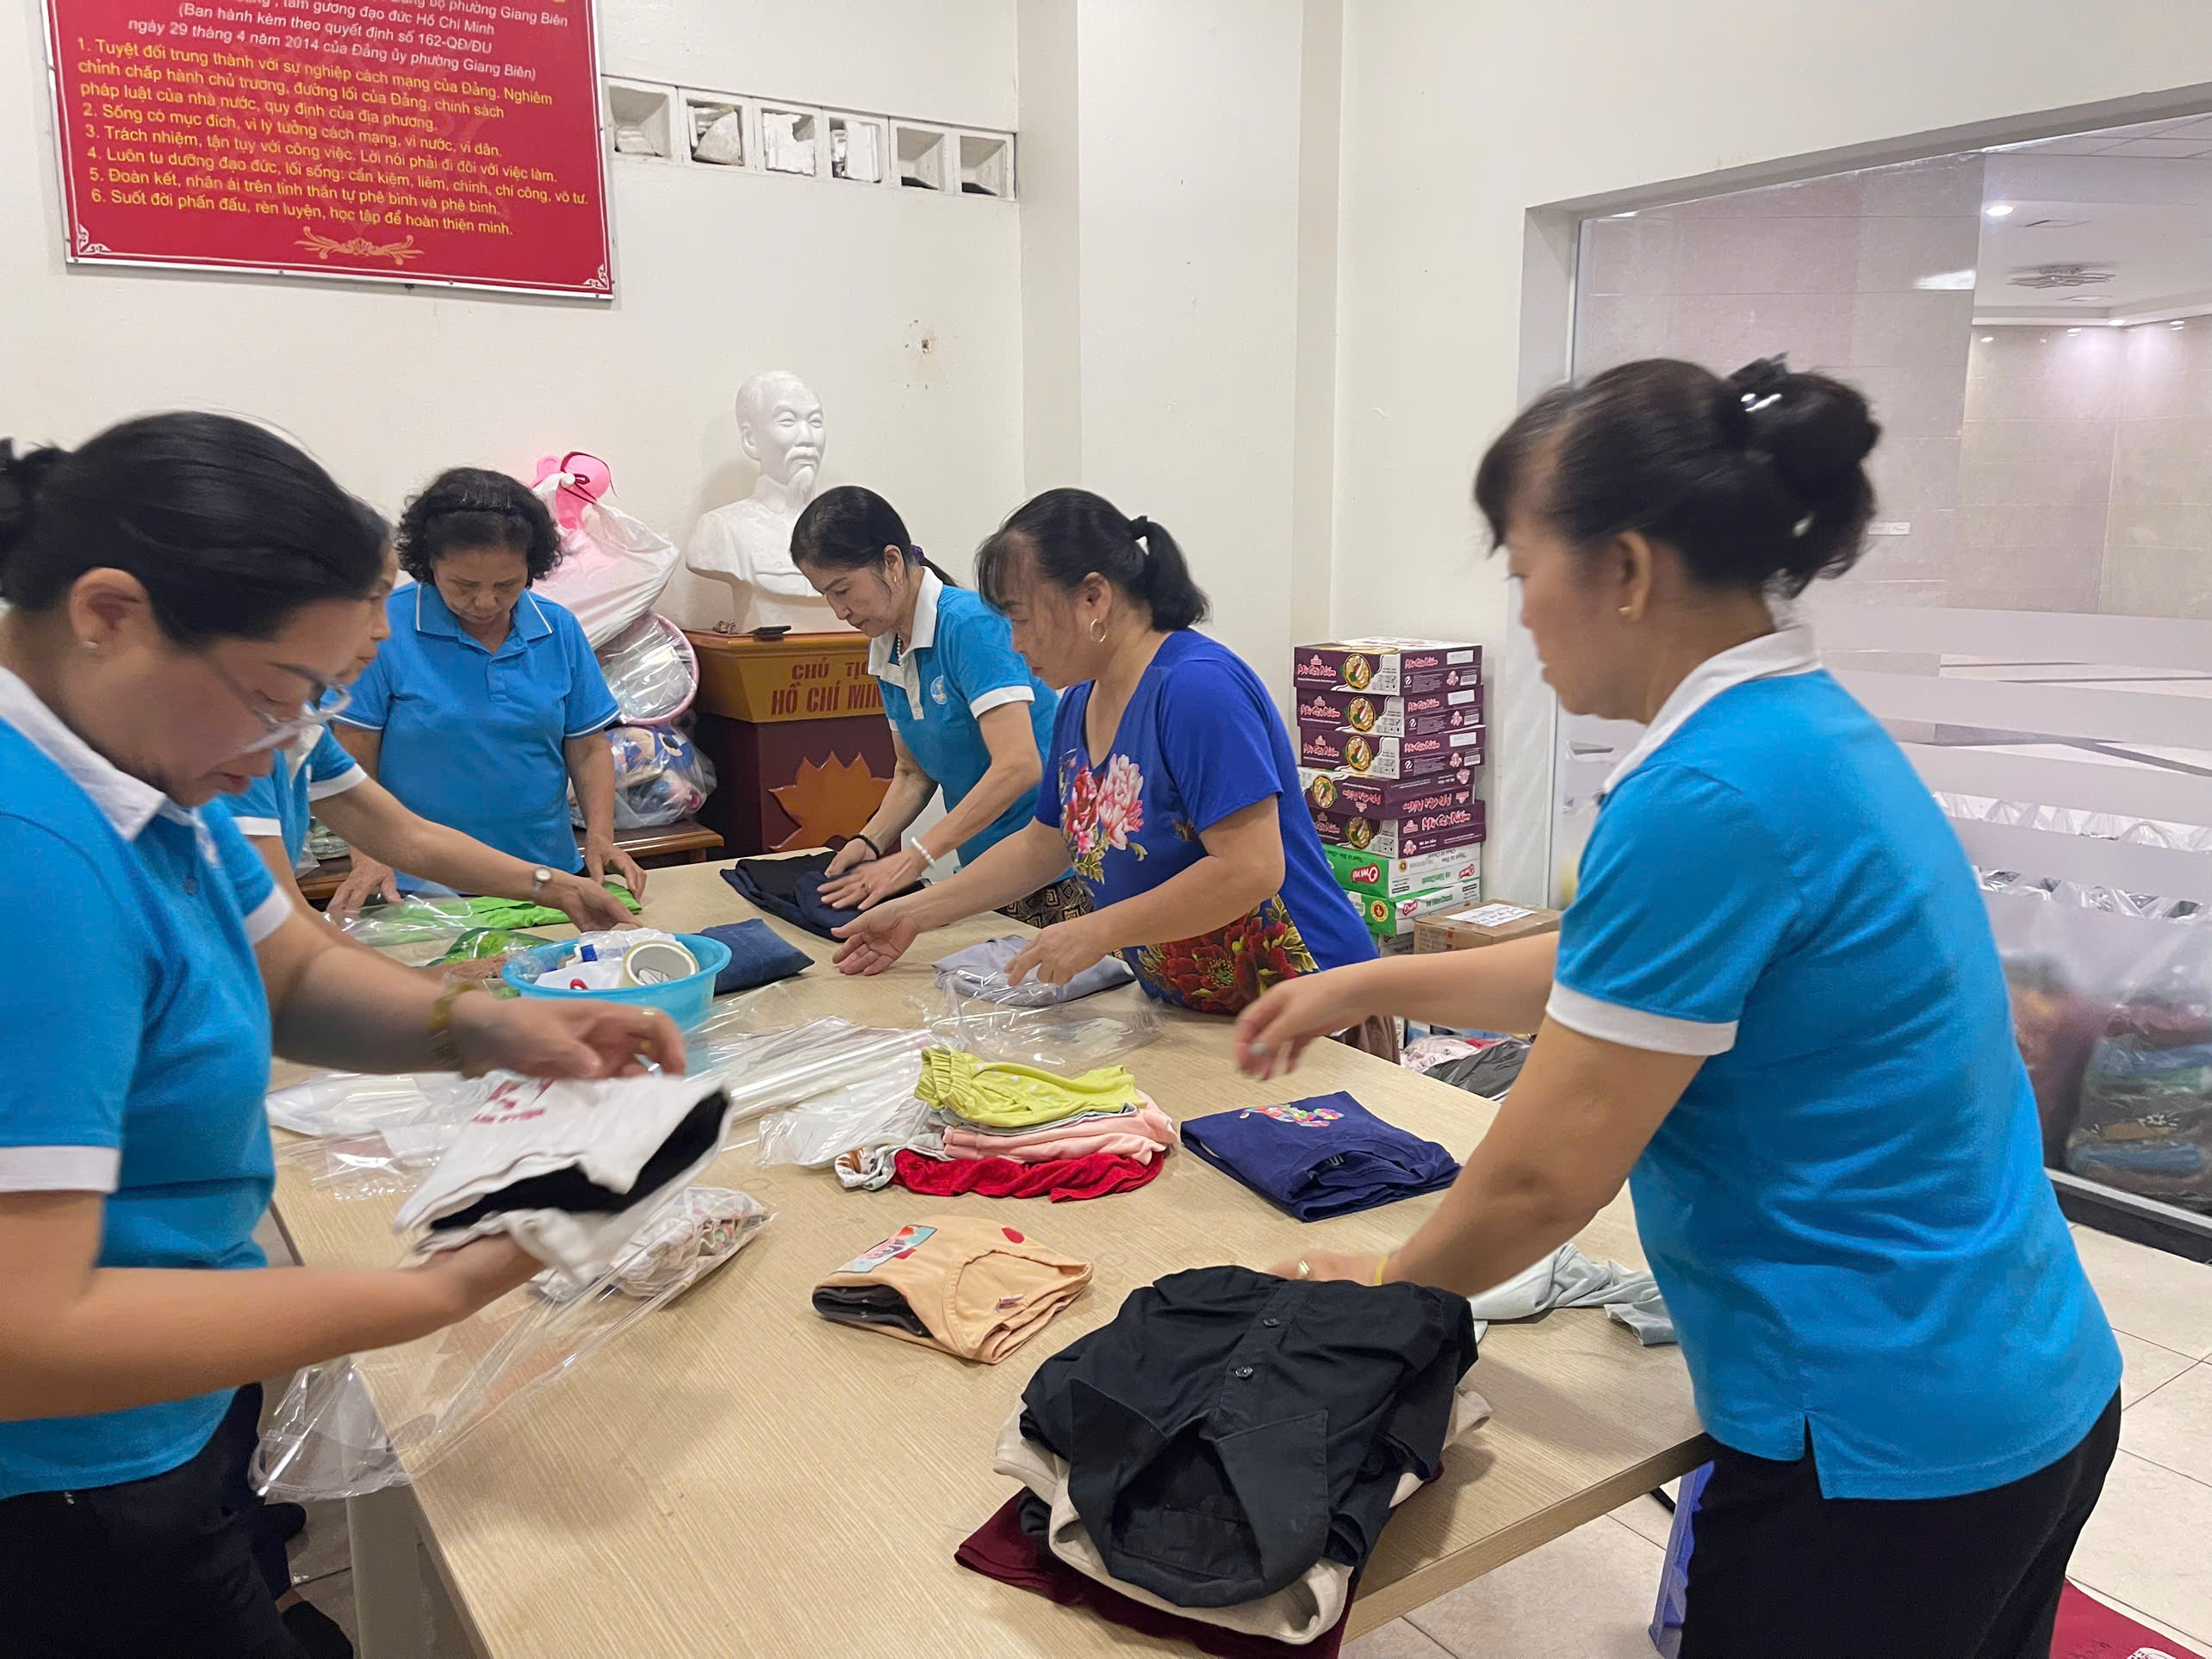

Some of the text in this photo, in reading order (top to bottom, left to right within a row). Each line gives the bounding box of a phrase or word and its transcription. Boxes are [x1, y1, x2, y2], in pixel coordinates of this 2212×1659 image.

[179, 3, 213, 18] (Ban
[217, 7, 252, 23] hành
[257, 12, 287, 27] kèm
[290, 16, 320, 31] theo
[325, 22, 362, 37] quyết
[366, 27, 394, 41] định
[398, 30, 414, 43] số
[313, 2, 356, 19] gương
[359, 6, 385, 21] đạo
[388, 9, 413, 23] đức
[439, 16, 460, 30] Chí
[464, 20, 494, 34] Minh
[449, 0, 496, 19] phường
[500, 6, 537, 25] Giang
[541, 12, 568, 27] Biên
[95, 39, 140, 59] Tuyệt
[143, 41, 165, 58] đối
[171, 48, 208, 67] trung
[213, 53, 254, 68] thành
[258, 58, 278, 71] với
[283, 62, 301, 76] sự
[304, 64, 351, 82] nghiệp
[356, 69, 388, 84] cách
[392, 76, 430, 92] mạng
[434, 78, 457, 93] của
[504, 87, 552, 105] Nghiêm
[128, 19, 536, 82] ngày 29 tháng 4 năm 2014 của Đảng ủy phường Giang Biên)
[78, 59, 121, 76] chỉnh
[125, 65, 162, 83] chấp
[166, 68, 204, 84] hành
[208, 73, 234, 87] chủ
[294, 82, 338, 101] đường
[342, 86, 357, 100] lối
[362, 89, 387, 103] của
[435, 99, 469, 114] chính
[474, 104, 504, 118] sách
[80, 82, 120, 100] pháp
[124, 84, 152, 103] luật
[156, 88, 183, 103] của
[264, 102, 289, 116] quy
[295, 103, 325, 118] định
[329, 105, 354, 121] của
[358, 109, 379, 125] địa
[103, 103, 143, 124] Sống
[170, 113, 202, 127] mục
[276, 120, 317, 140] tưởng
[321, 126, 354, 140] cách
[103, 125, 147, 142] Trách
[207, 134, 229, 151] tận
[260, 140, 281, 152] với
[285, 142, 320, 160] công
[360, 149, 381, 163] Lời
[385, 152, 405, 165] nói
[409, 154, 438, 170] phải
[441, 158, 453, 171] đi
[457, 160, 476, 173] đôi
[480, 163, 499, 176] với
[502, 165, 528, 181] việc
[107, 147, 145, 163] Luôn
[149, 151, 164, 165] tu
[219, 157, 246, 173] đạo
[283, 161, 301, 175] lối
[495, 184, 513, 196] chí
[109, 168, 149, 183] Đoàn
[186, 175, 223, 190] nhân
[227, 177, 240, 191] ái
[244, 179, 272, 193] trên
[342, 188, 356, 203] tự
[358, 190, 384, 204] phê
[388, 192, 418, 206] bình
[421, 196, 438, 208] và
[441, 198, 465, 212] phê
[111, 190, 147, 205] Suốt
[151, 192, 173, 207] đời
[178, 194, 214, 209] phấn
[255, 201, 279, 214] rèn
[330, 207, 355, 223] học
[359, 209, 381, 225] tập
[384, 209, 401, 225] để
[406, 214, 438, 228] hoàn
[443, 217, 475, 233] thiện
[792, 657, 868, 680] CHỦ TỊC
[772, 680, 883, 715] HỒ CHÍ MIN
